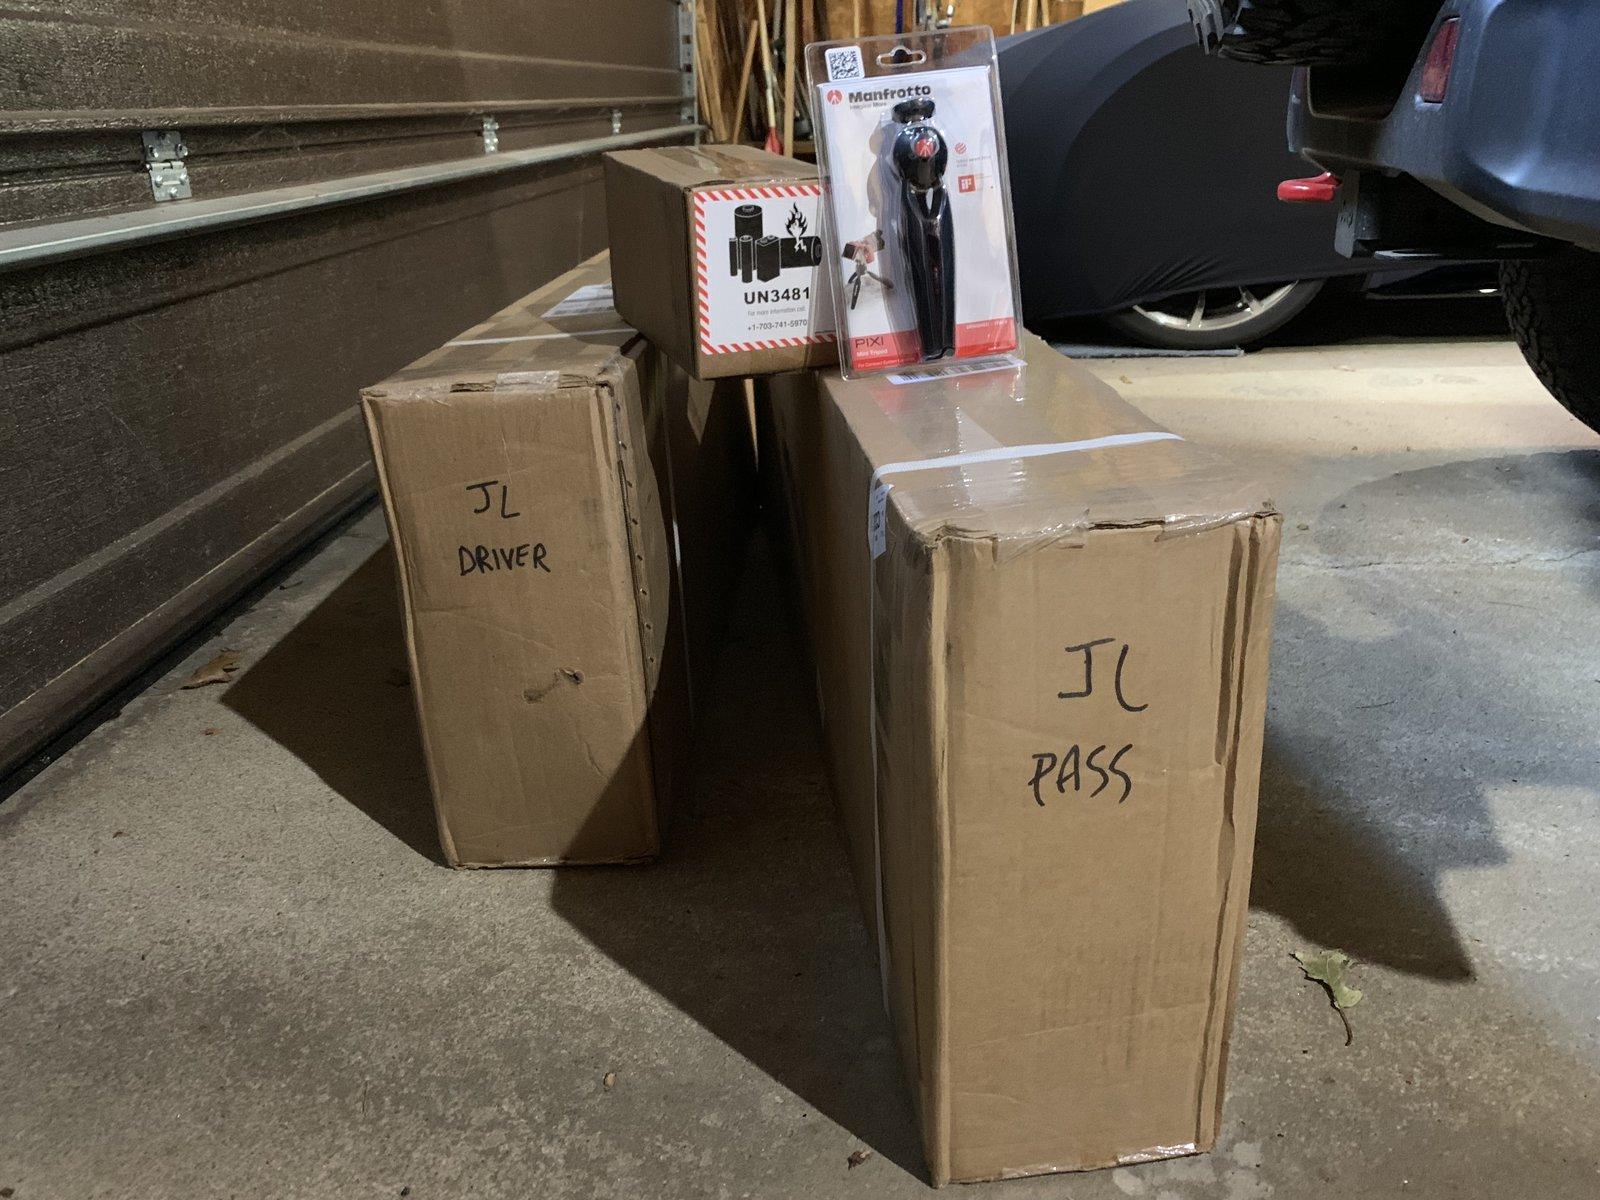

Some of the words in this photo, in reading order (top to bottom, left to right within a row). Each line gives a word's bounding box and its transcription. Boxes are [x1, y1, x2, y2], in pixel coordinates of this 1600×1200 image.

[848, 85, 931, 103] Manfrotto
[744, 287, 810, 304] UN3481
[748, 319, 808, 331] +1-703-741-5970
[855, 336, 884, 349] PIXI
[466, 480, 520, 518] JL
[459, 543, 551, 576] DRIVER
[1028, 744, 1133, 806] PASS
